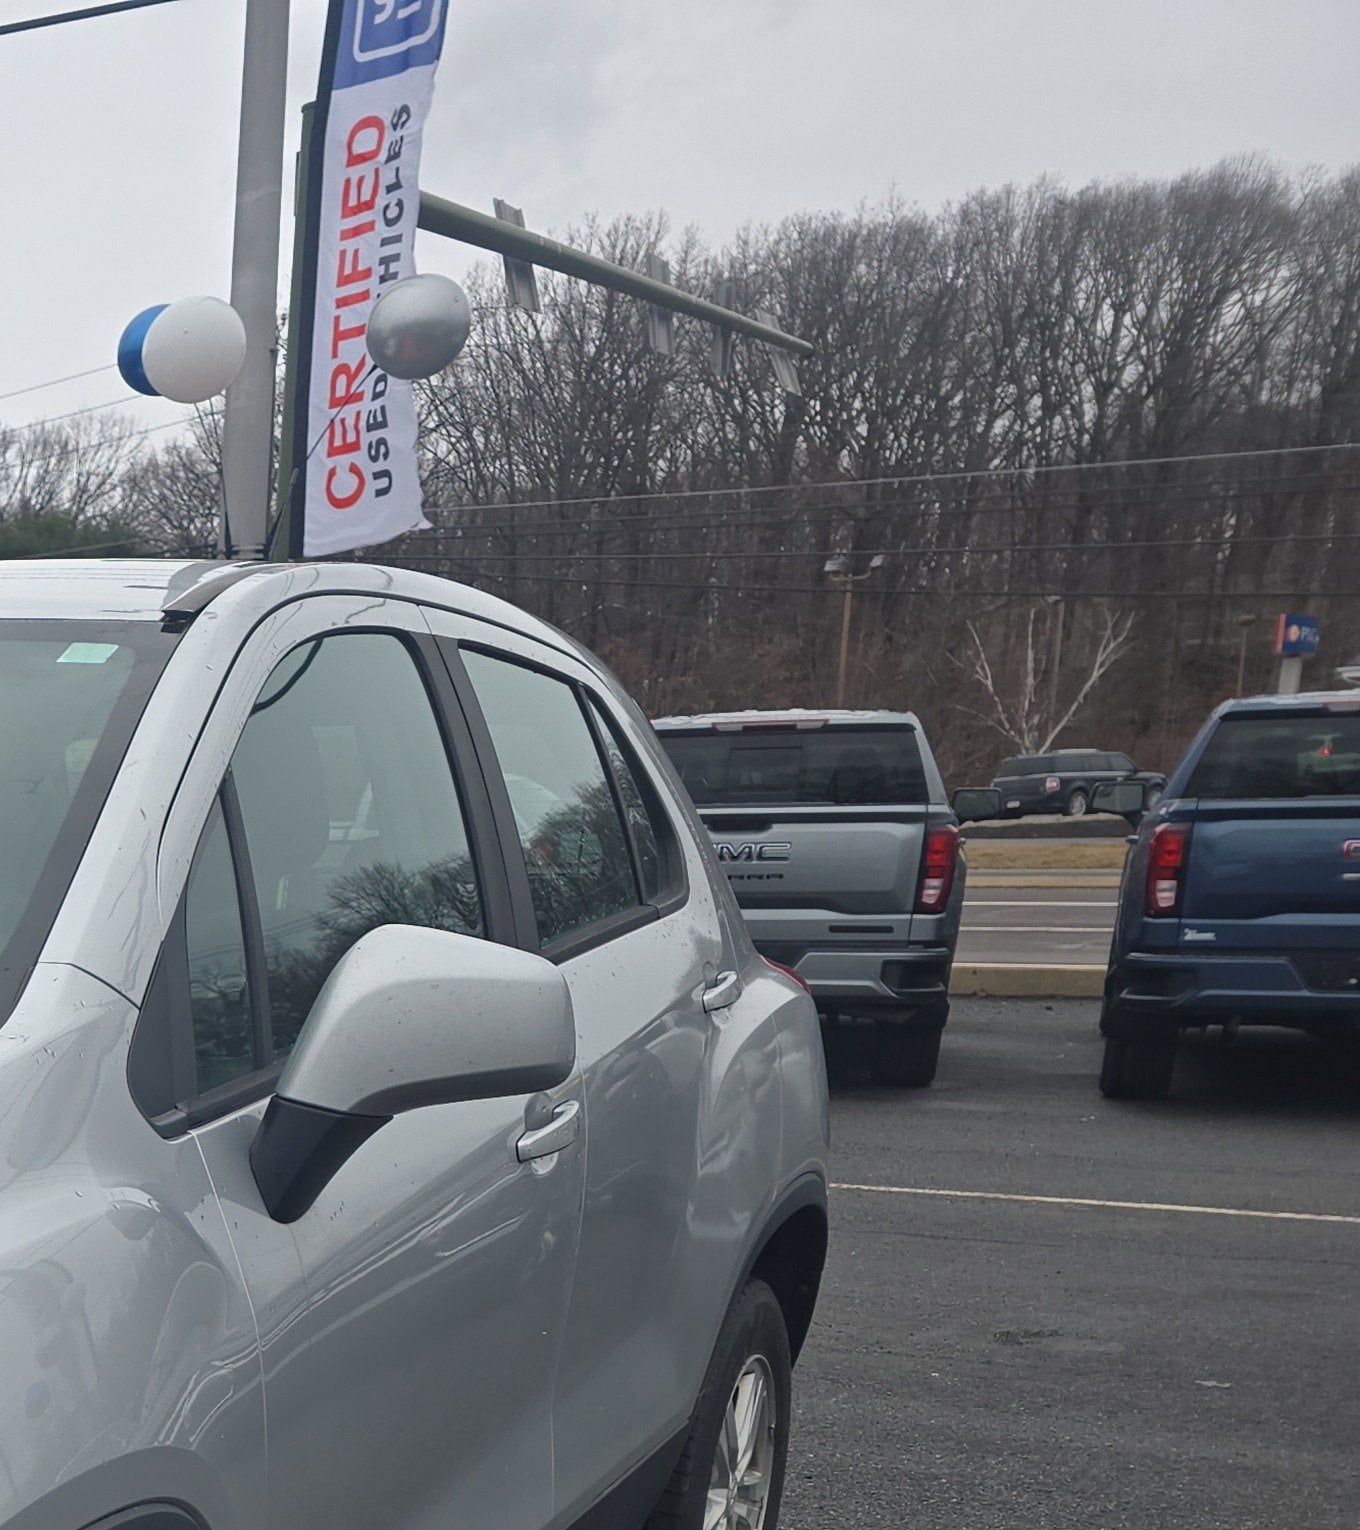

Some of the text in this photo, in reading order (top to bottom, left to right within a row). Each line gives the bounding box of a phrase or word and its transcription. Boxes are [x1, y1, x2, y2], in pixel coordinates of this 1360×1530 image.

[326, 115, 386, 509] CERTIFIED
[366, 373, 393, 498] USED
[713, 841, 791, 864] MC
